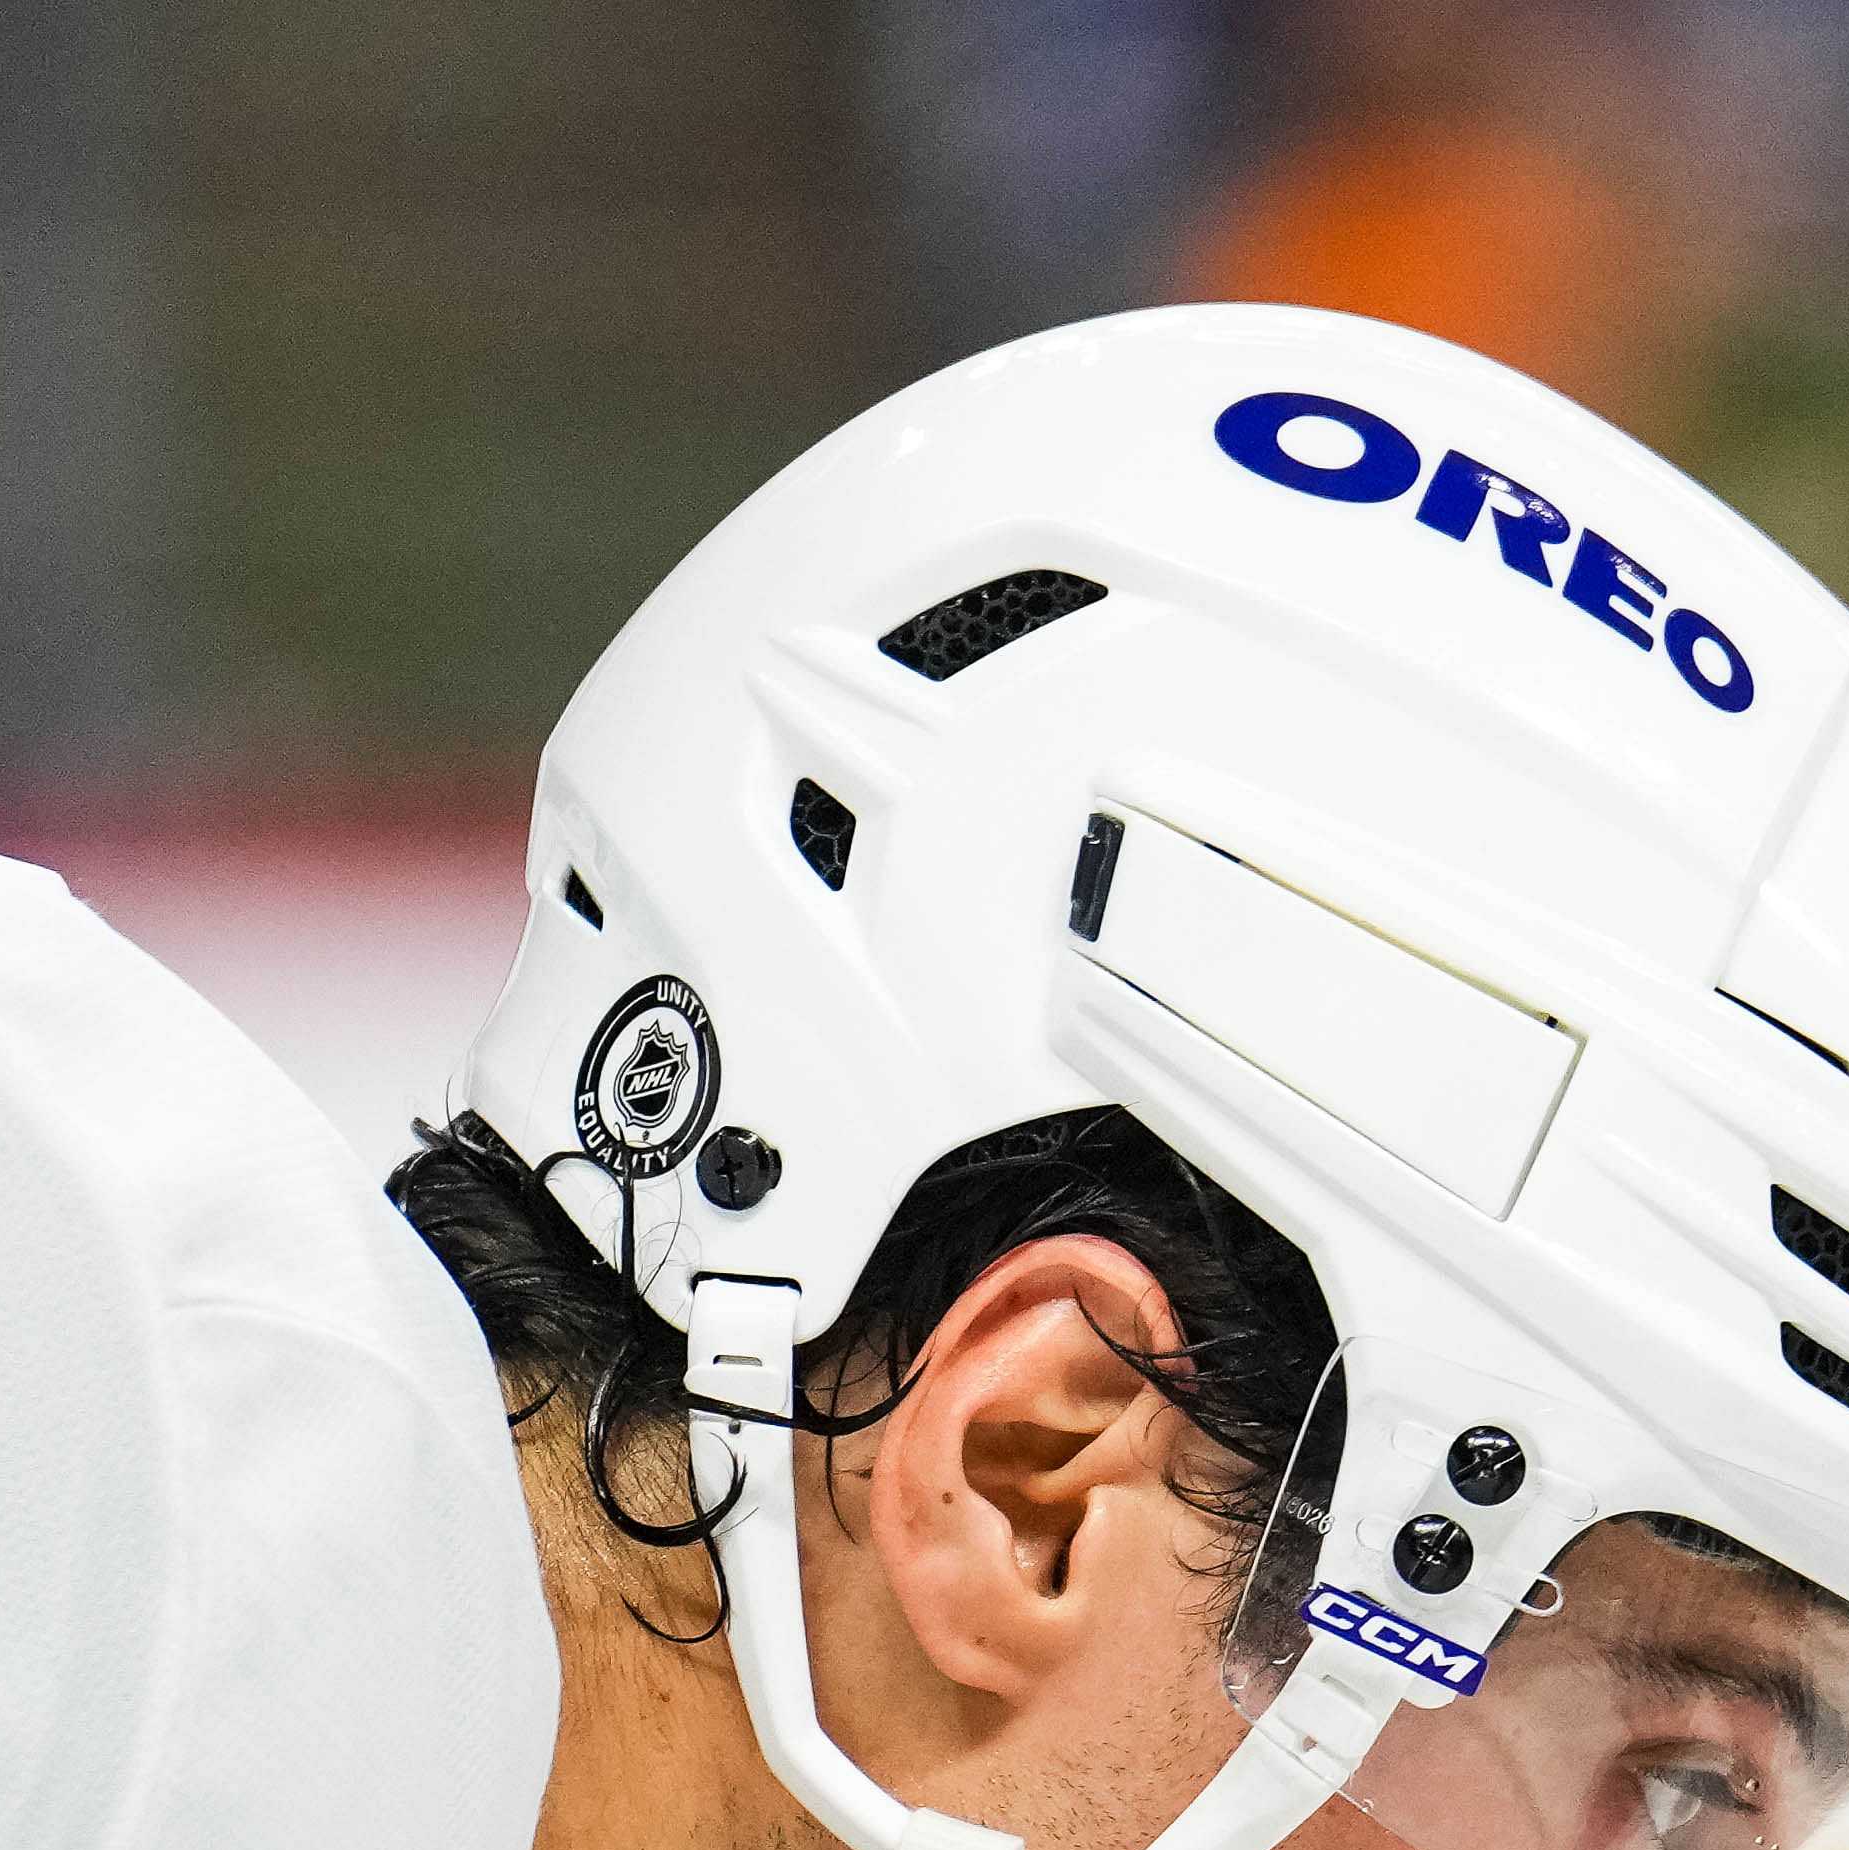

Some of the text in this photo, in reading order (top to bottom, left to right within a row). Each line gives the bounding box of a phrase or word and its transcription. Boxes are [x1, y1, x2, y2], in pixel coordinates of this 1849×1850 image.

[1214, 391, 1755, 713] OREO
[656, 980, 710, 1030] UNITY
[626, 1065, 675, 1095] NHL
[578, 1091, 671, 1174] EQUALITY
[1307, 1591, 1479, 1682] CCM
